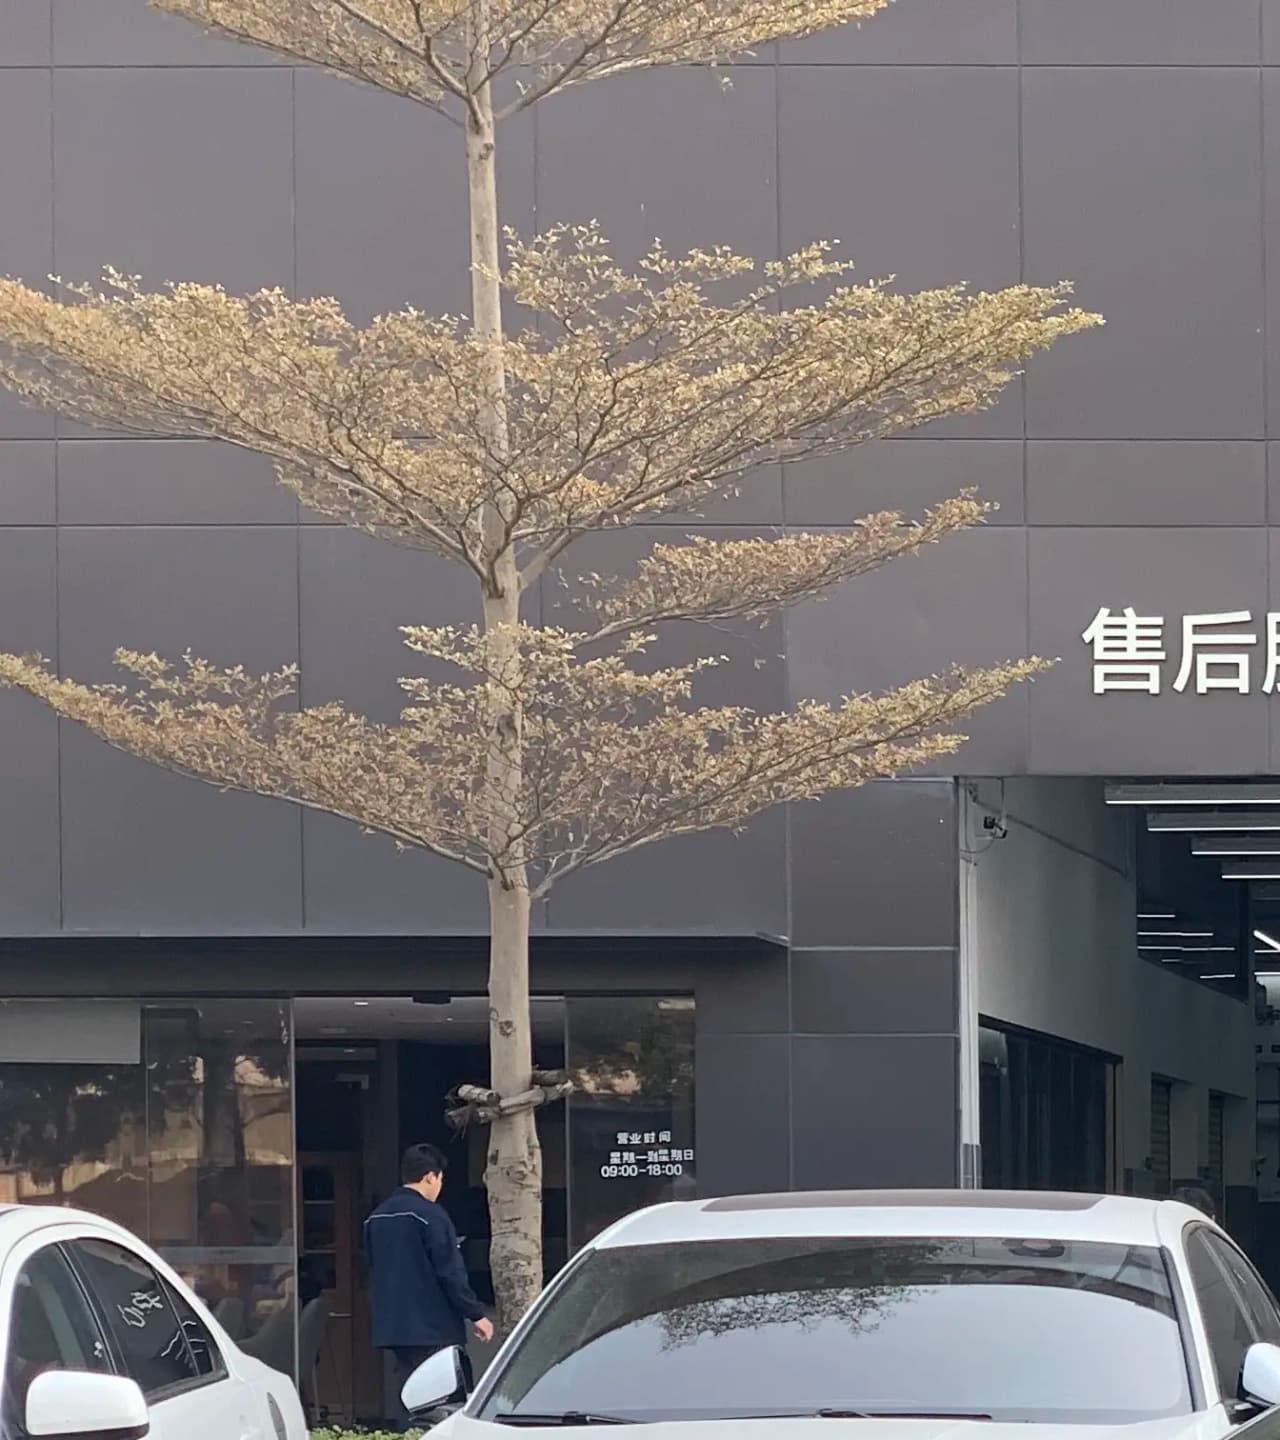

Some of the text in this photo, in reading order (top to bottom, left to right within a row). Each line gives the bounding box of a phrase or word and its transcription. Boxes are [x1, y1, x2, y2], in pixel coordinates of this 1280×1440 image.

[617, 1131, 671, 1144] 营业时间
[609, 1149, 694, 1164] 星期一到星期日
[601, 1164, 682, 1177] 09:00-18:00
